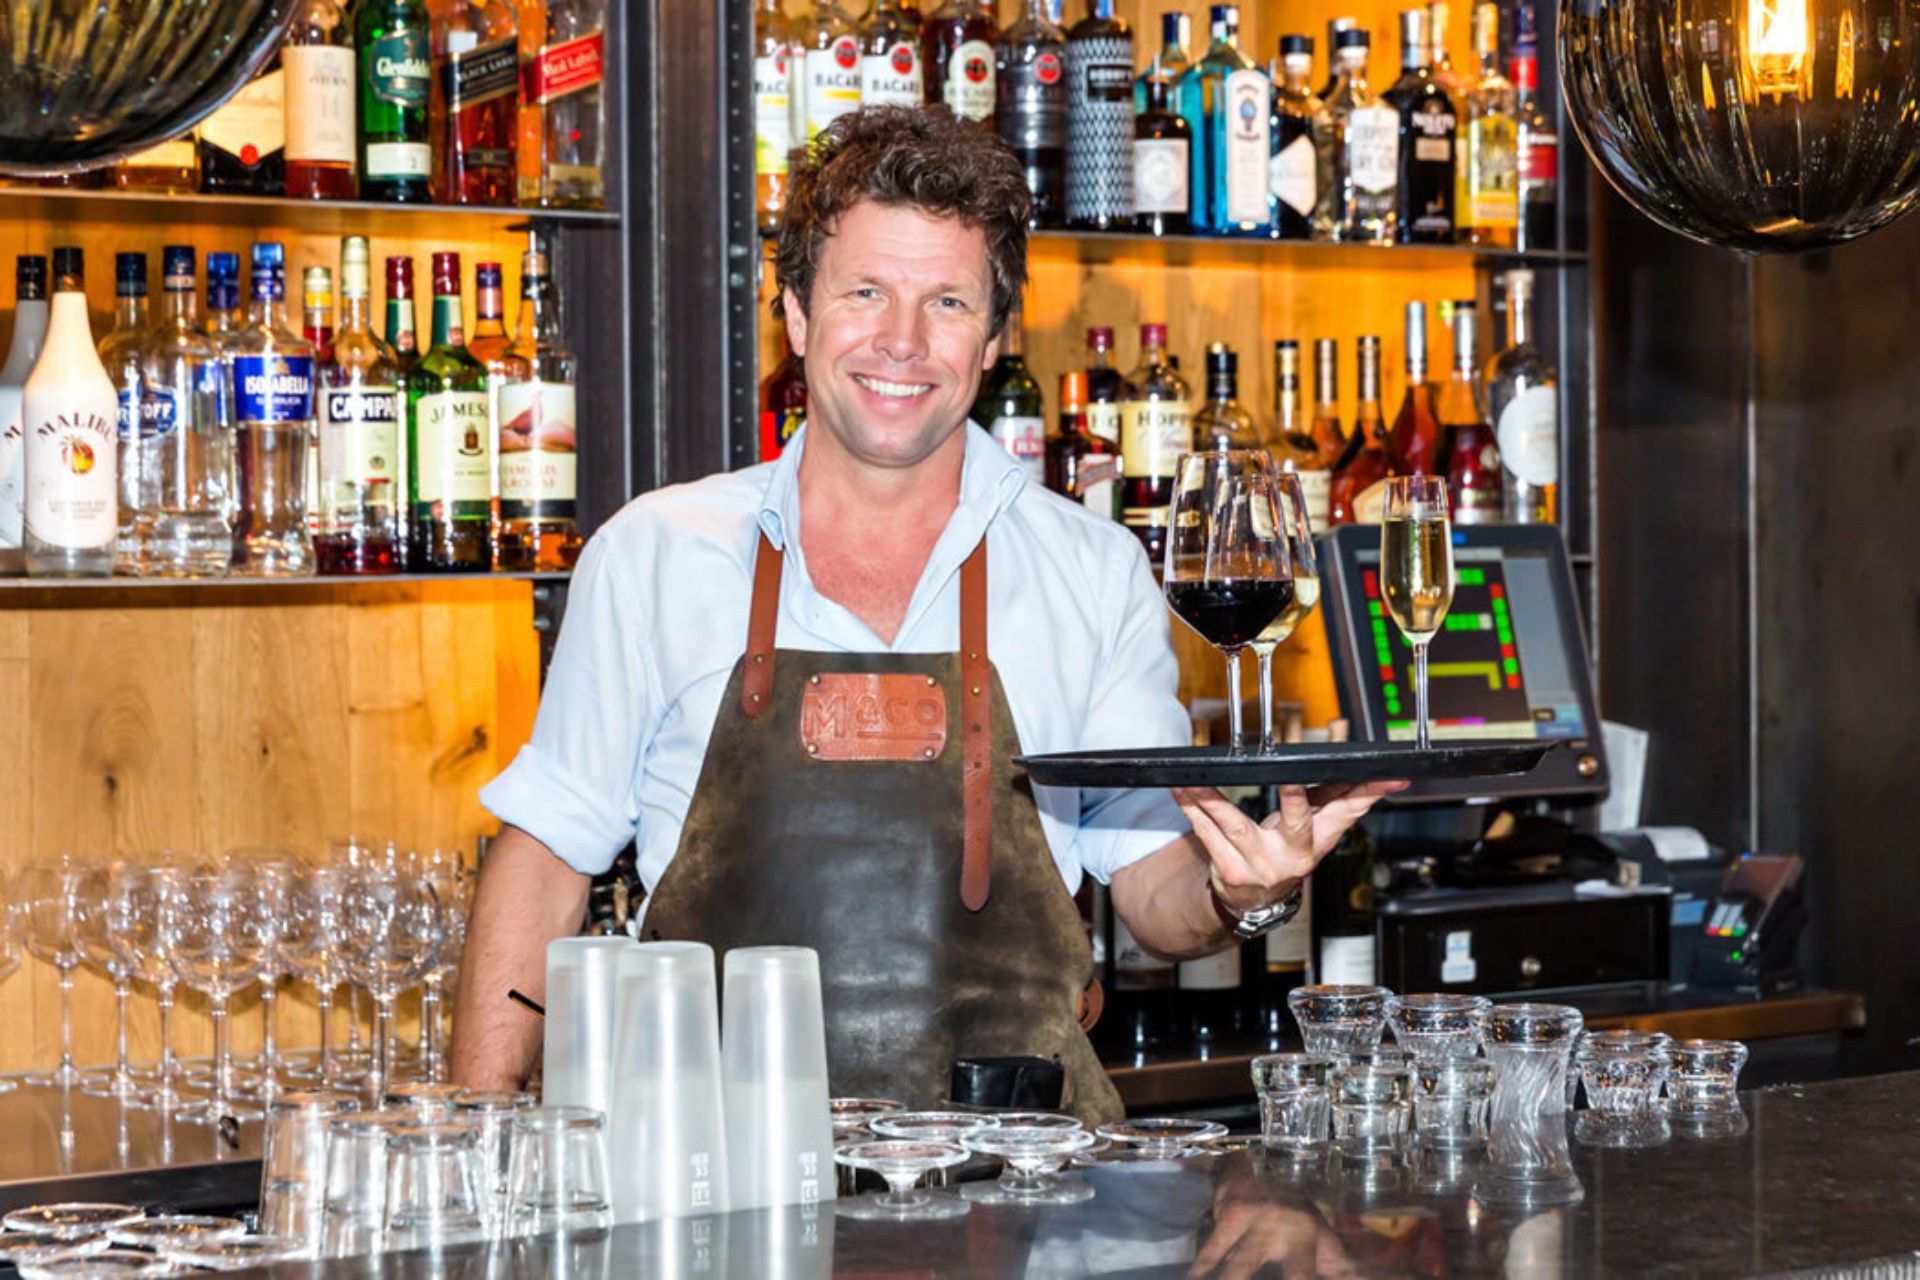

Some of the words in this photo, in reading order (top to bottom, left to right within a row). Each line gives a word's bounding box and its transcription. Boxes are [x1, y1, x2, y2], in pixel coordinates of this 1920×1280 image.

[245, 376, 309, 394] ISOABELL
[331, 395, 396, 419] CAMPA
[431, 402, 489, 423] JMES
